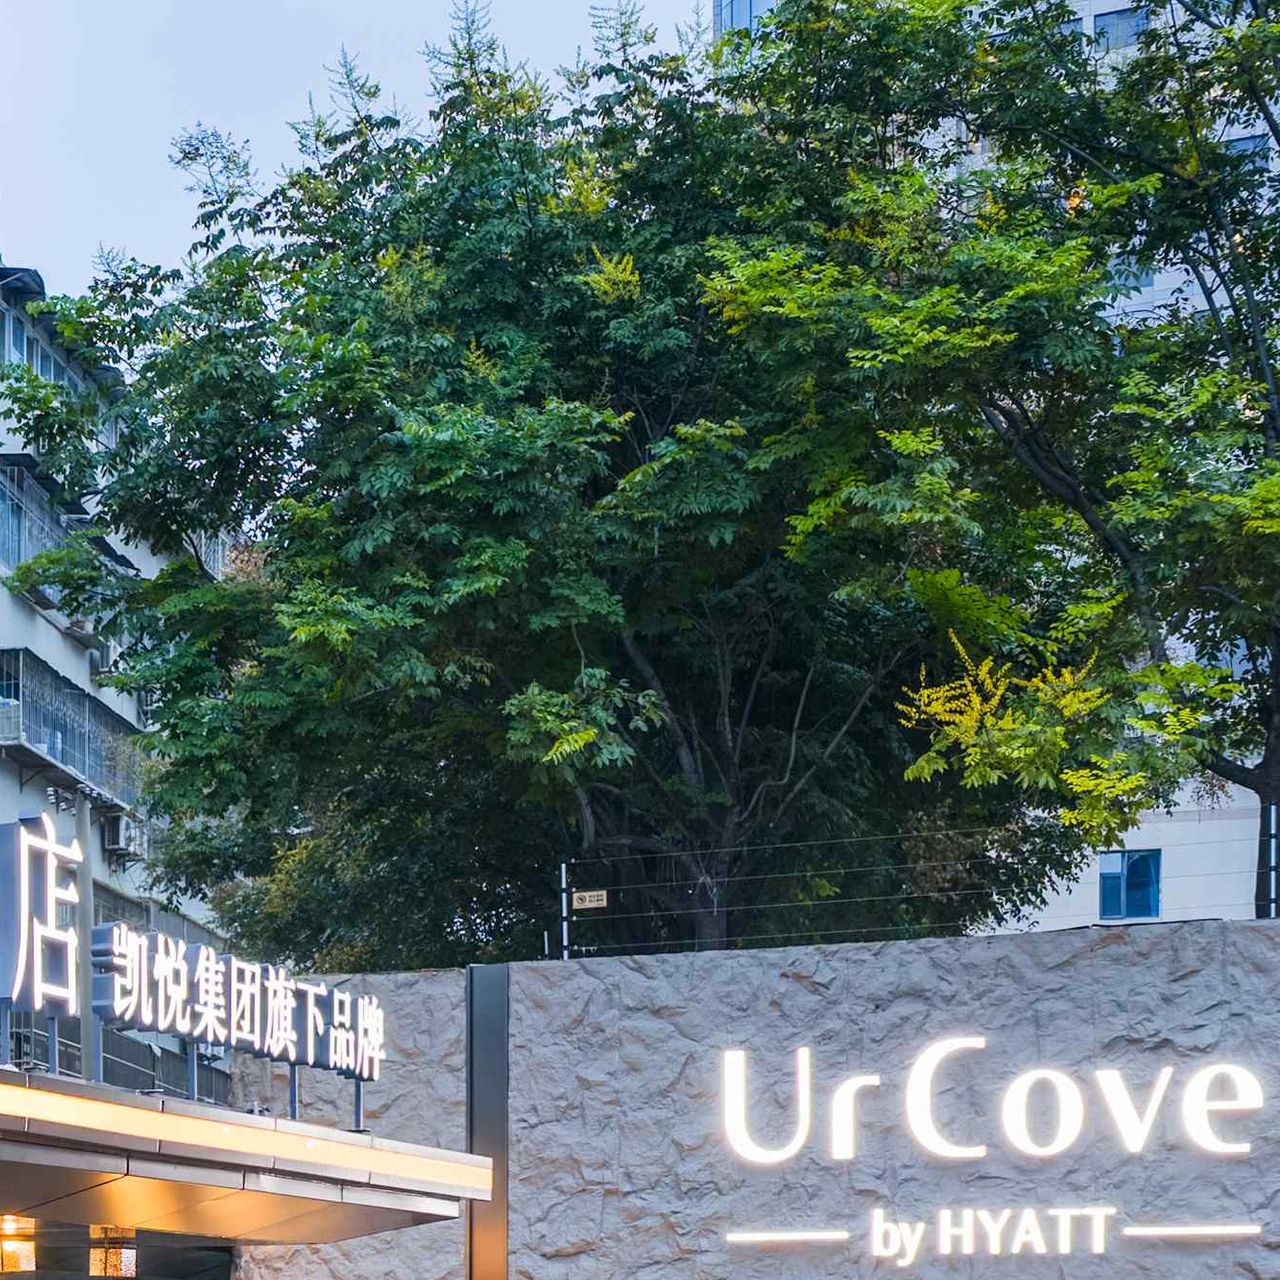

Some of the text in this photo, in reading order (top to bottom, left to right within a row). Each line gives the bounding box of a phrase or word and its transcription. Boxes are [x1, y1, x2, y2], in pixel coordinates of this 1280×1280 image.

[111, 922, 387, 1082] 凯悦集团旗下品牌
[721, 1036, 1266, 1165] UrCove
[870, 1206, 1117, 1266] by HYATT
